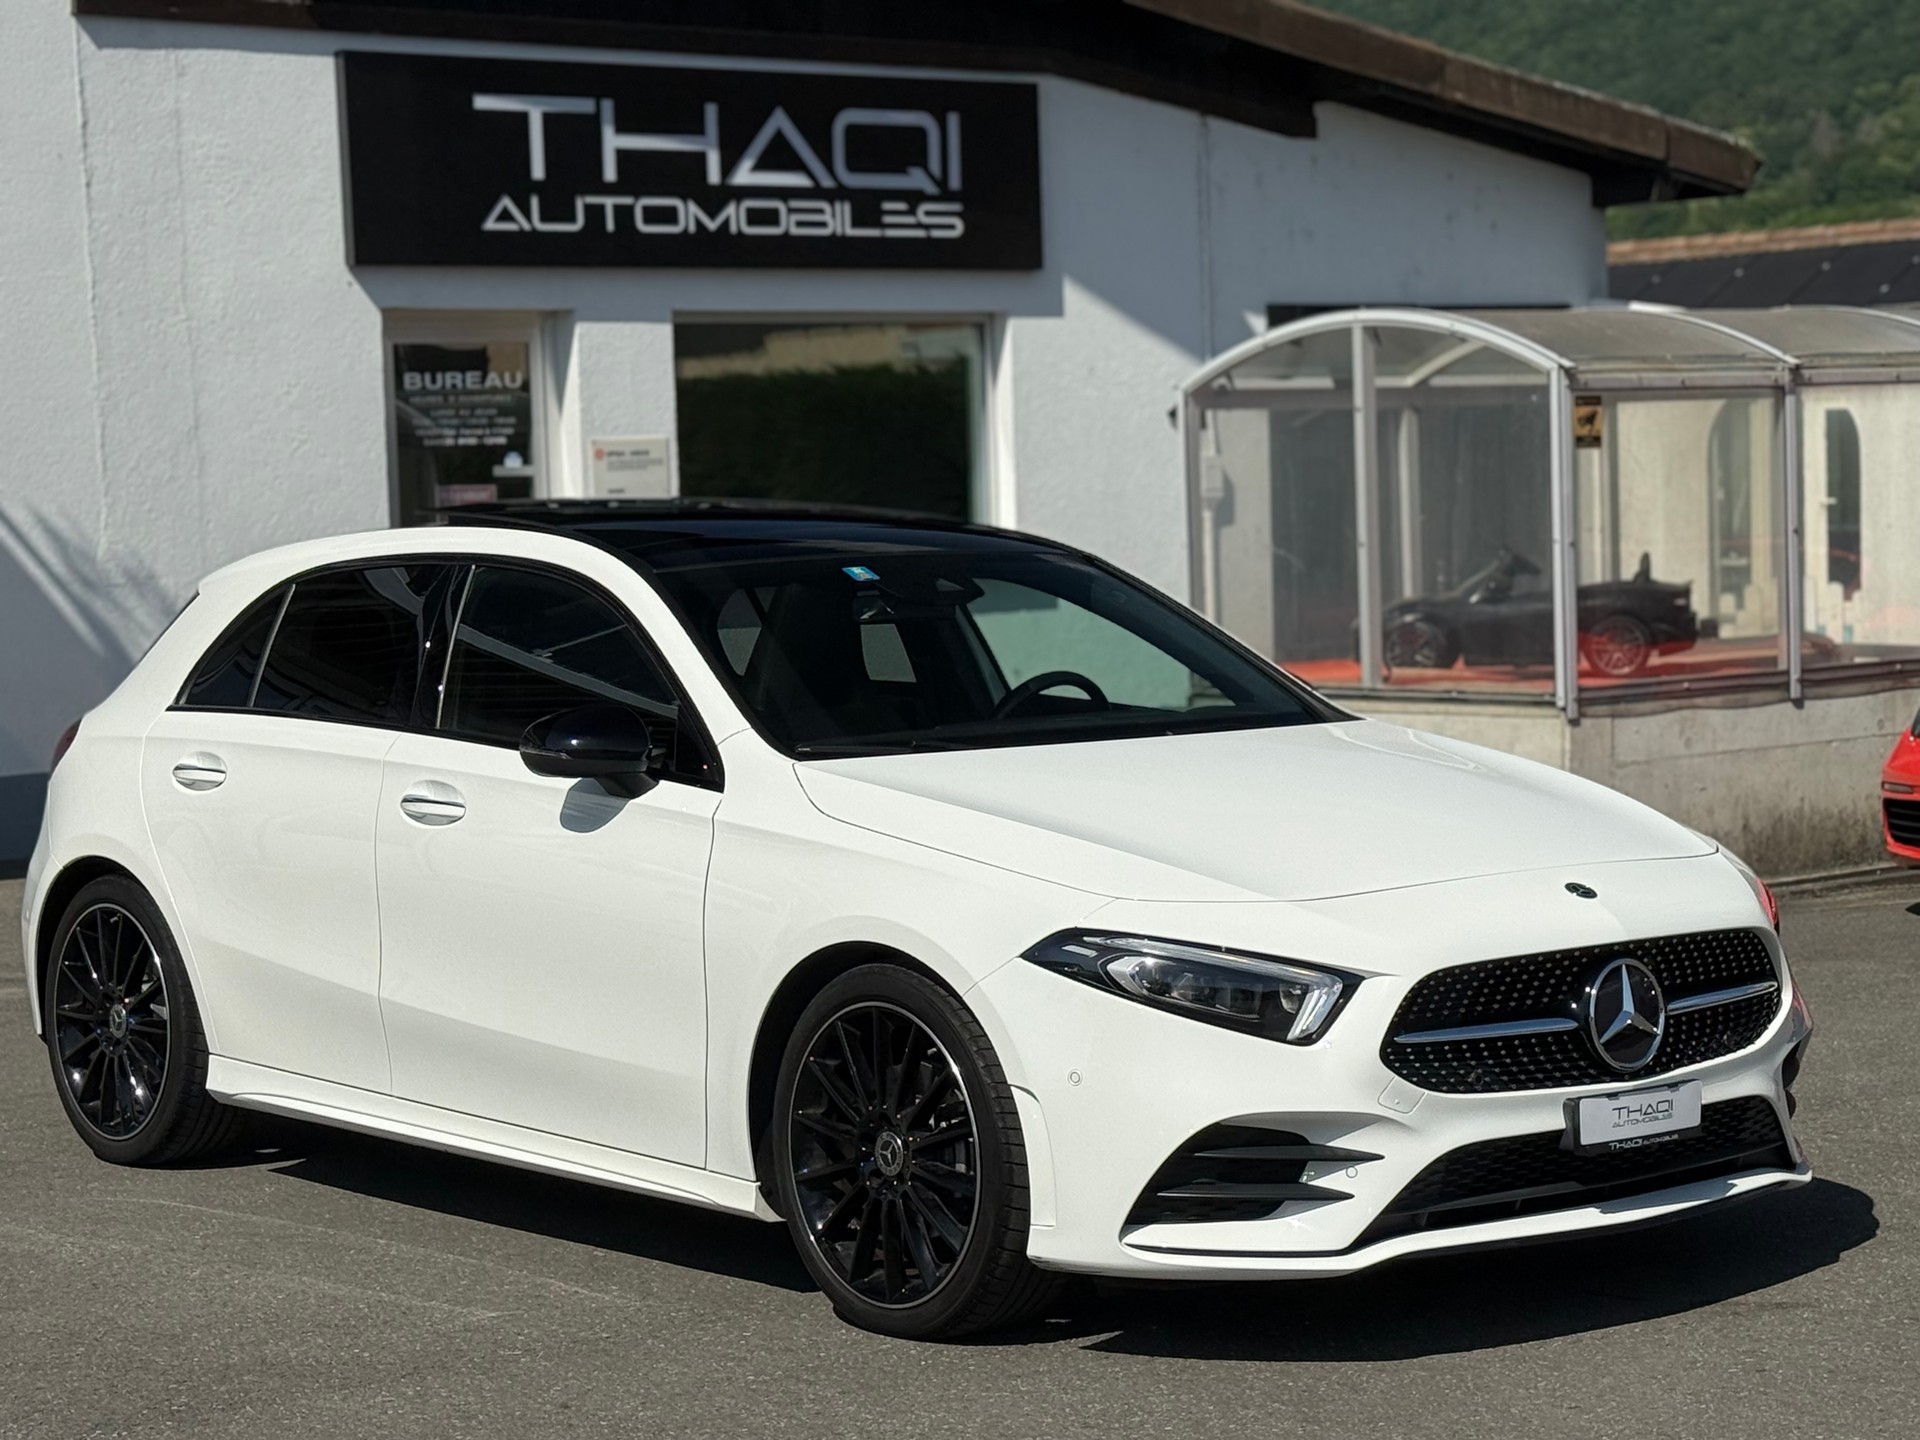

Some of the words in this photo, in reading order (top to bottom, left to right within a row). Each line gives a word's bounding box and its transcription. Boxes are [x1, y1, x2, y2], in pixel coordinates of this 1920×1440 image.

[472, 93, 962, 195] THAQI
[481, 194, 965, 239] AUTOMOBILES
[403, 371, 523, 391] BUREAU
[1612, 1099, 1673, 1120] THAQI
[1612, 1112, 1673, 1128] AUTOMOBILES
[1609, 1139, 1643, 1150] THAQI
